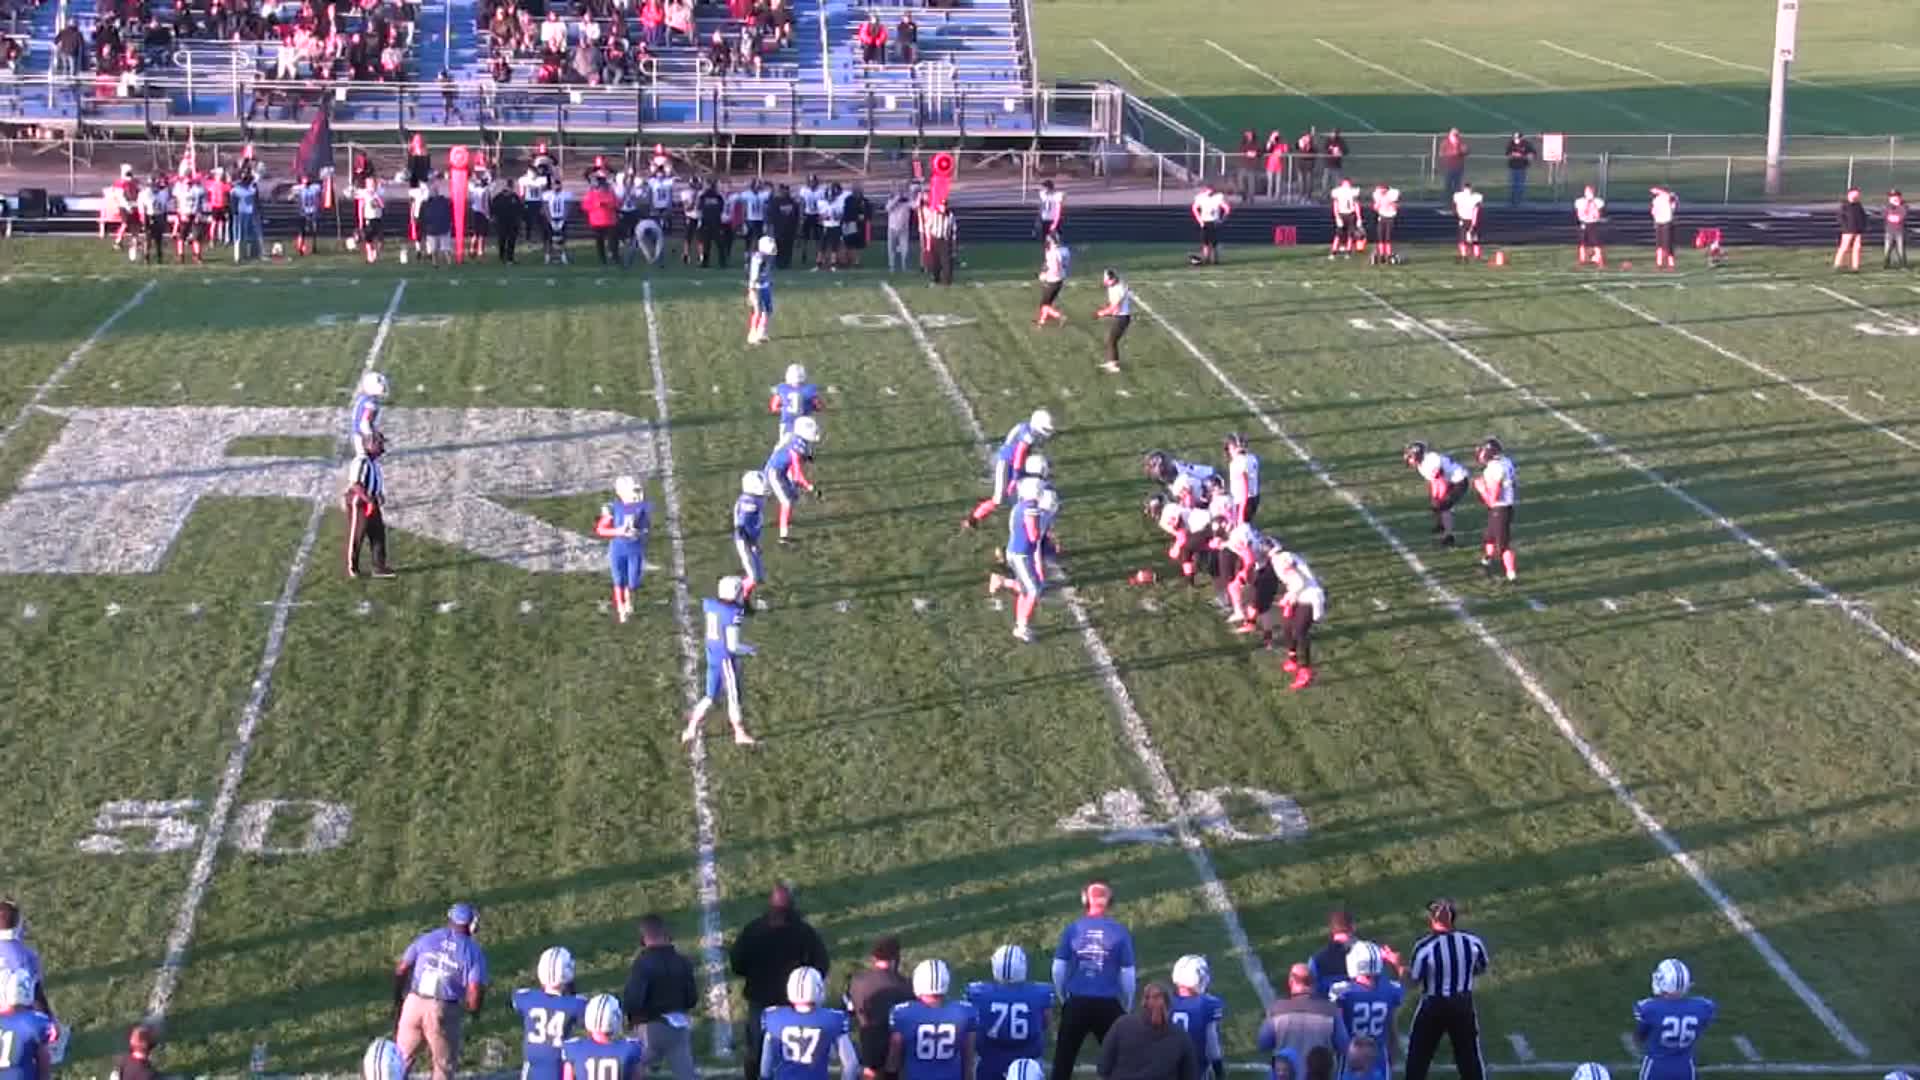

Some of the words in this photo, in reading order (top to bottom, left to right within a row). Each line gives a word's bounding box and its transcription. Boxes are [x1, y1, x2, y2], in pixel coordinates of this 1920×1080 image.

[75, 799, 354, 855] 50
[528, 1007, 566, 1047] 34
[986, 1001, 1030, 1040] 76
[1352, 1001, 1389, 1037] 22
[1660, 1015, 1699, 1049] 26
[0, 1029, 14, 1068] 1
[781, 1025, 822, 1065] 67
[915, 1023, 957, 1060] 62
